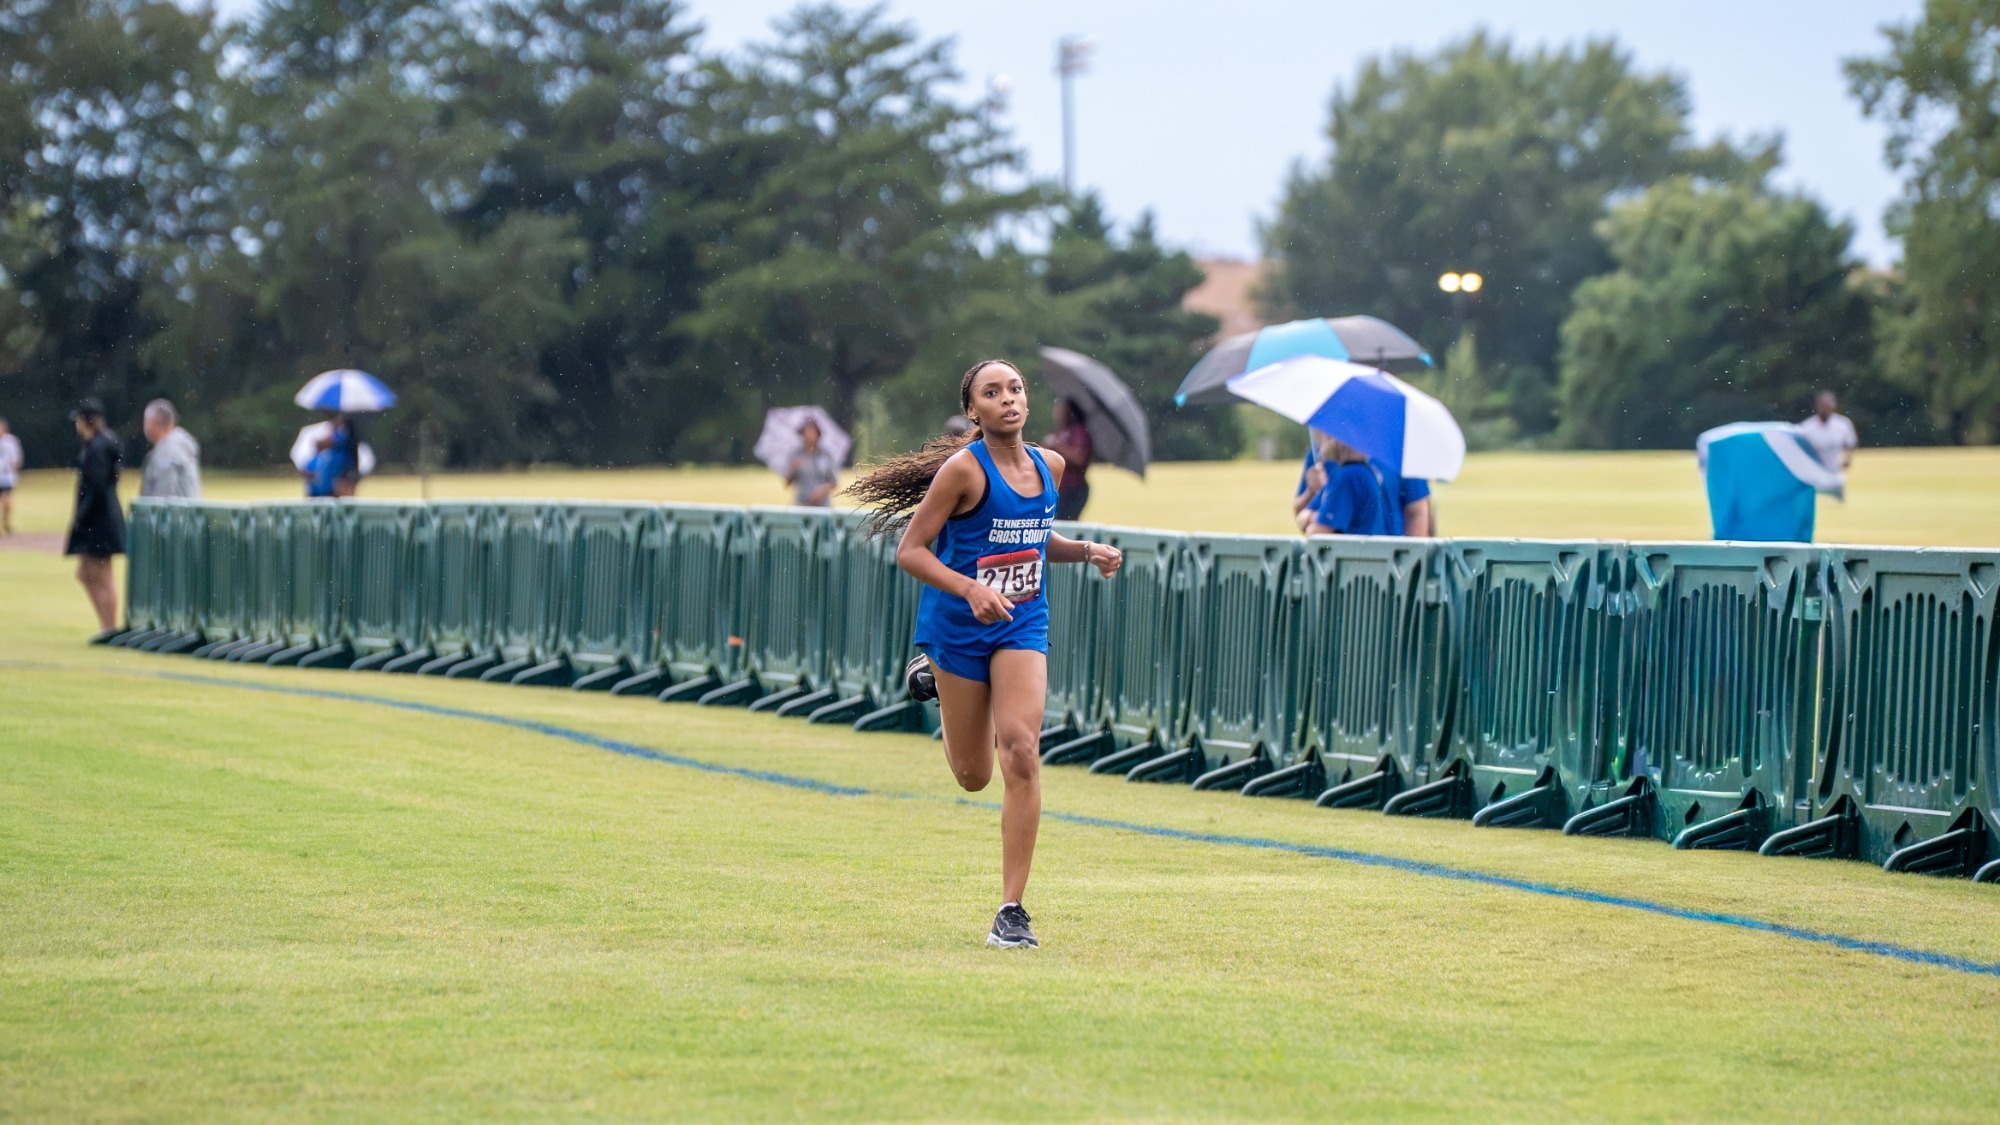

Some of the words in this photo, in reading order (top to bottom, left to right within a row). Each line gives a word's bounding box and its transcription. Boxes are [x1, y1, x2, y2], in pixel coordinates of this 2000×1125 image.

[992, 518, 1040, 528] TENNESSEE
[988, 529, 1021, 544] CROSS
[983, 562, 1037, 594] 2754
